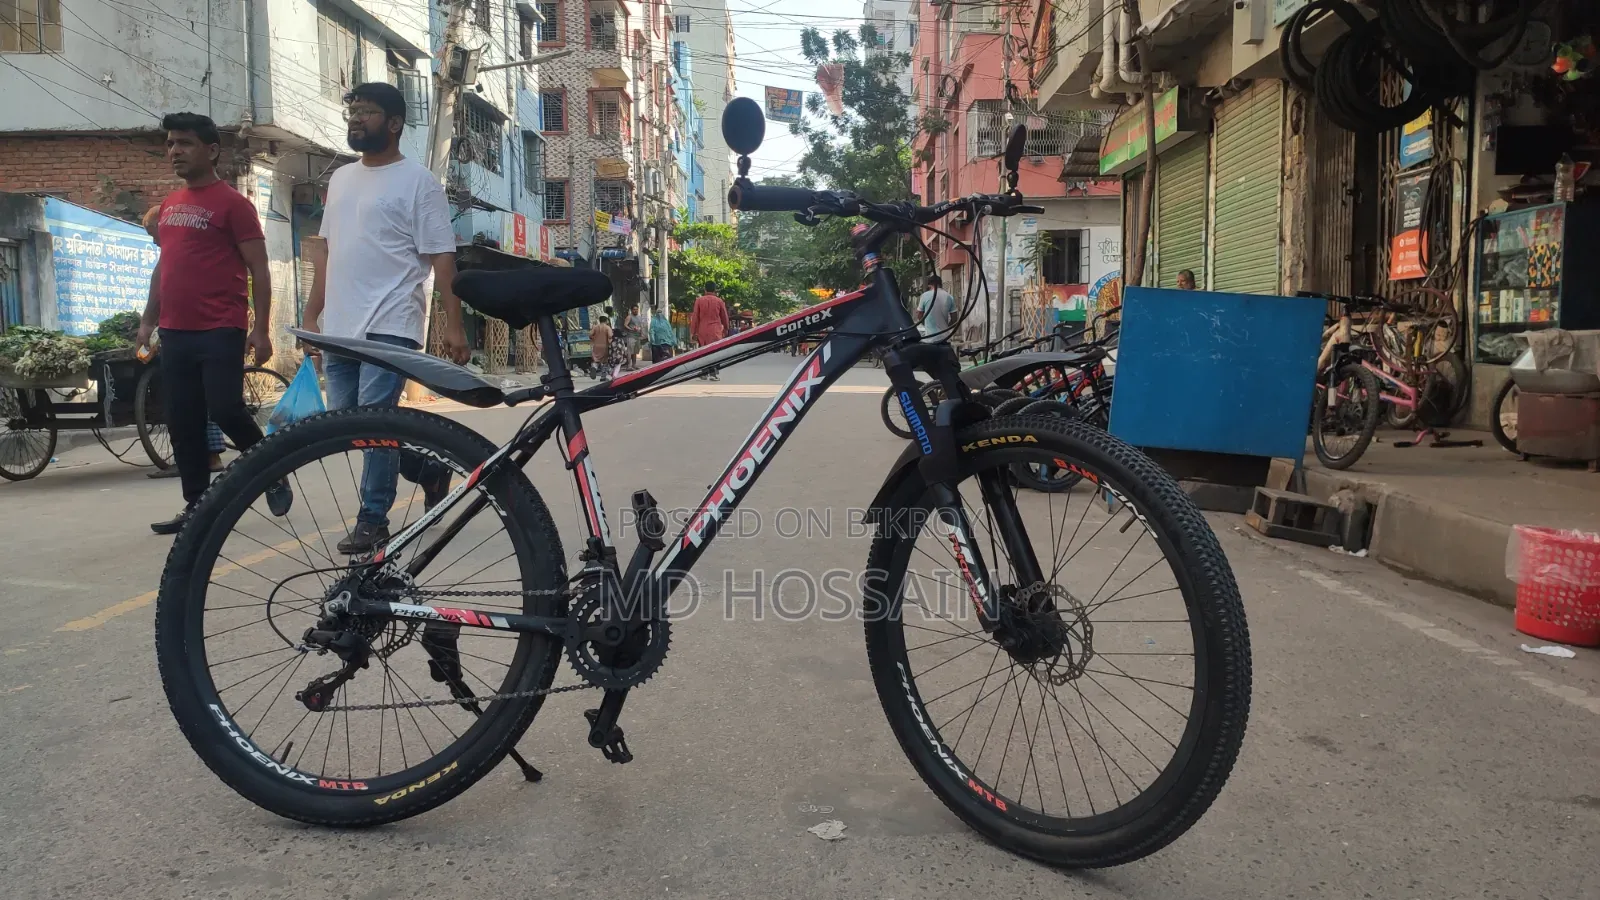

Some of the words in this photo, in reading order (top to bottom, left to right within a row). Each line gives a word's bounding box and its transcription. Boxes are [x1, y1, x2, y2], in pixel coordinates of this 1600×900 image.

[165, 212, 209, 230] ARBOVIRUS
[900, 391, 932, 455] SHIMANO
[351, 439, 399, 448] MTB
[684, 363, 826, 549] PHOENIX
[962, 434, 1038, 453] KENDA
[1053, 457, 1098, 484] MTB
[393, 608, 464, 623] PHOENIX
[208, 703, 317, 785] PHOENIX
[318, 779, 369, 790] MTB
[897, 661, 968, 780] PHOENIX
[967, 779, 1008, 812] MTB
[373, 761, 459, 806] KENDA
